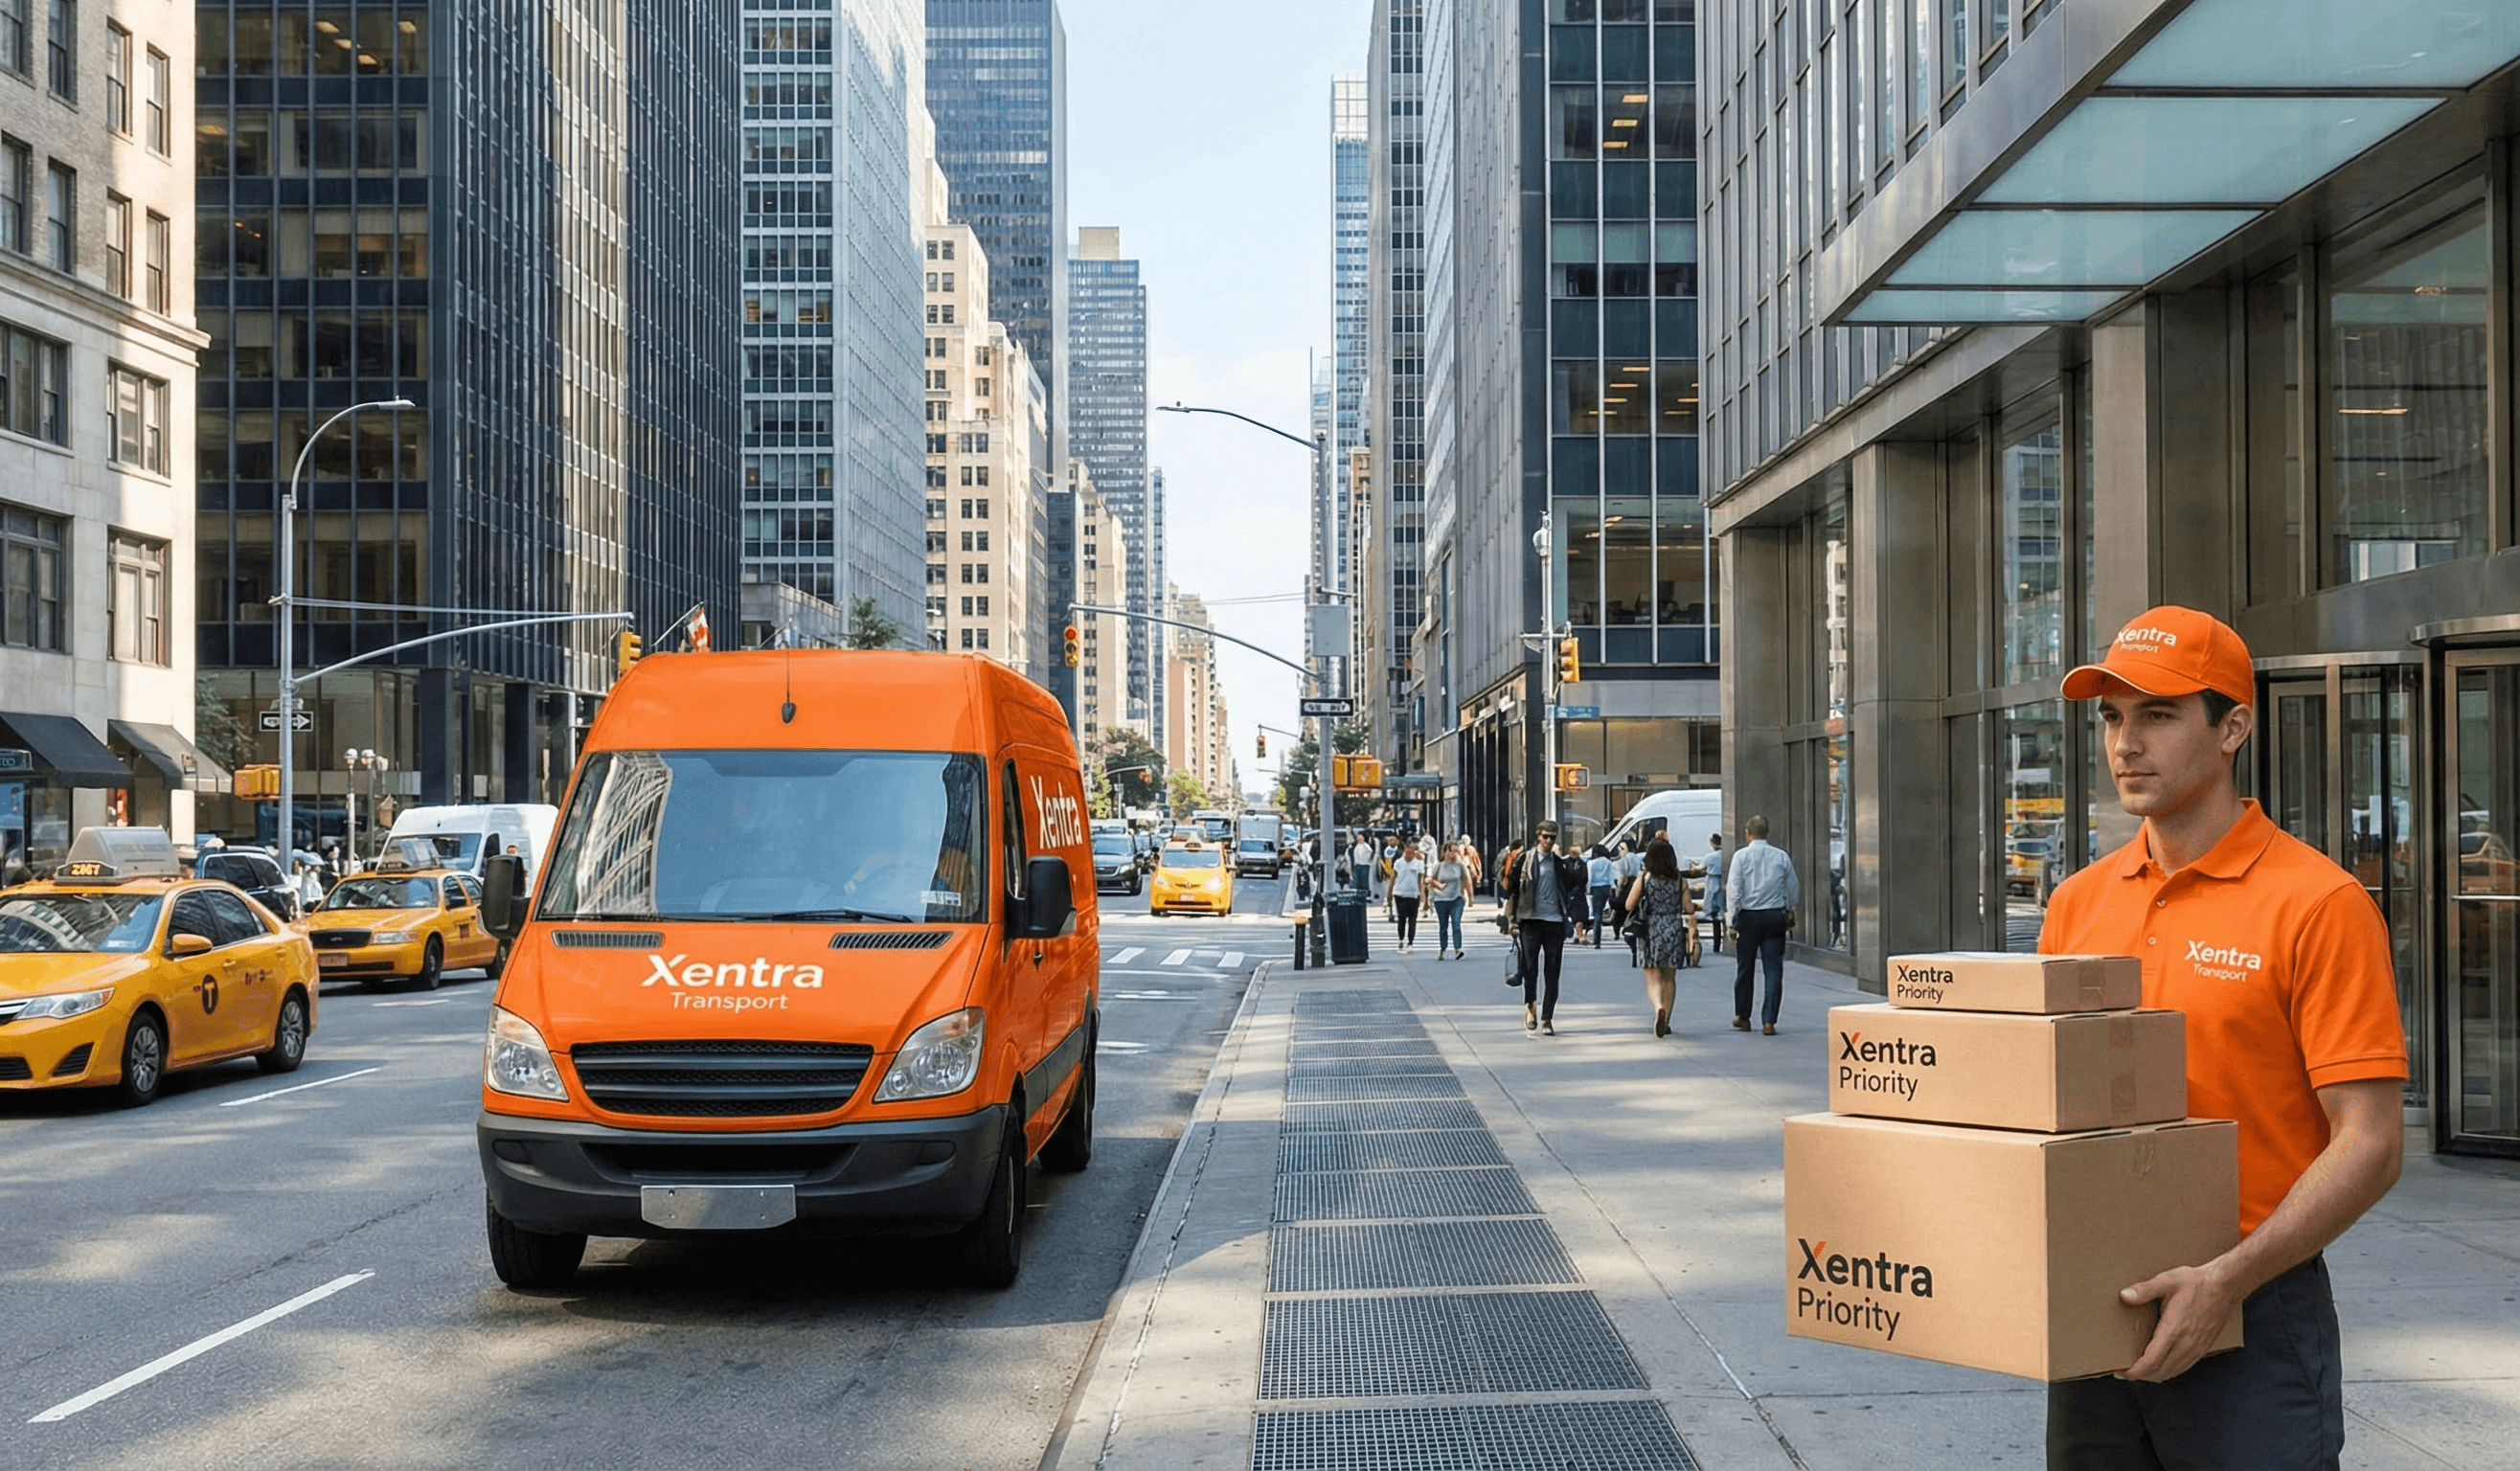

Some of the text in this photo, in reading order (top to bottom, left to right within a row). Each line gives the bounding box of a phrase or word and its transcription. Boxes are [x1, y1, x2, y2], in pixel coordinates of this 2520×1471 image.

[1030, 775, 1083, 849] Xentra
[640, 954, 824, 988] Xentra
[2184, 939, 2261, 970] Xentra
[1897, 964, 1953, 984] Xentra
[670, 991, 788, 1013] Transport
[1897, 984, 1943, 1004] Priority
[1840, 1030, 1936, 1067] Xentra
[1840, 1066, 1918, 1101] Priority
[1798, 1238, 1933, 1298] Xentra
[1798, 1287, 1900, 1341] Priority
